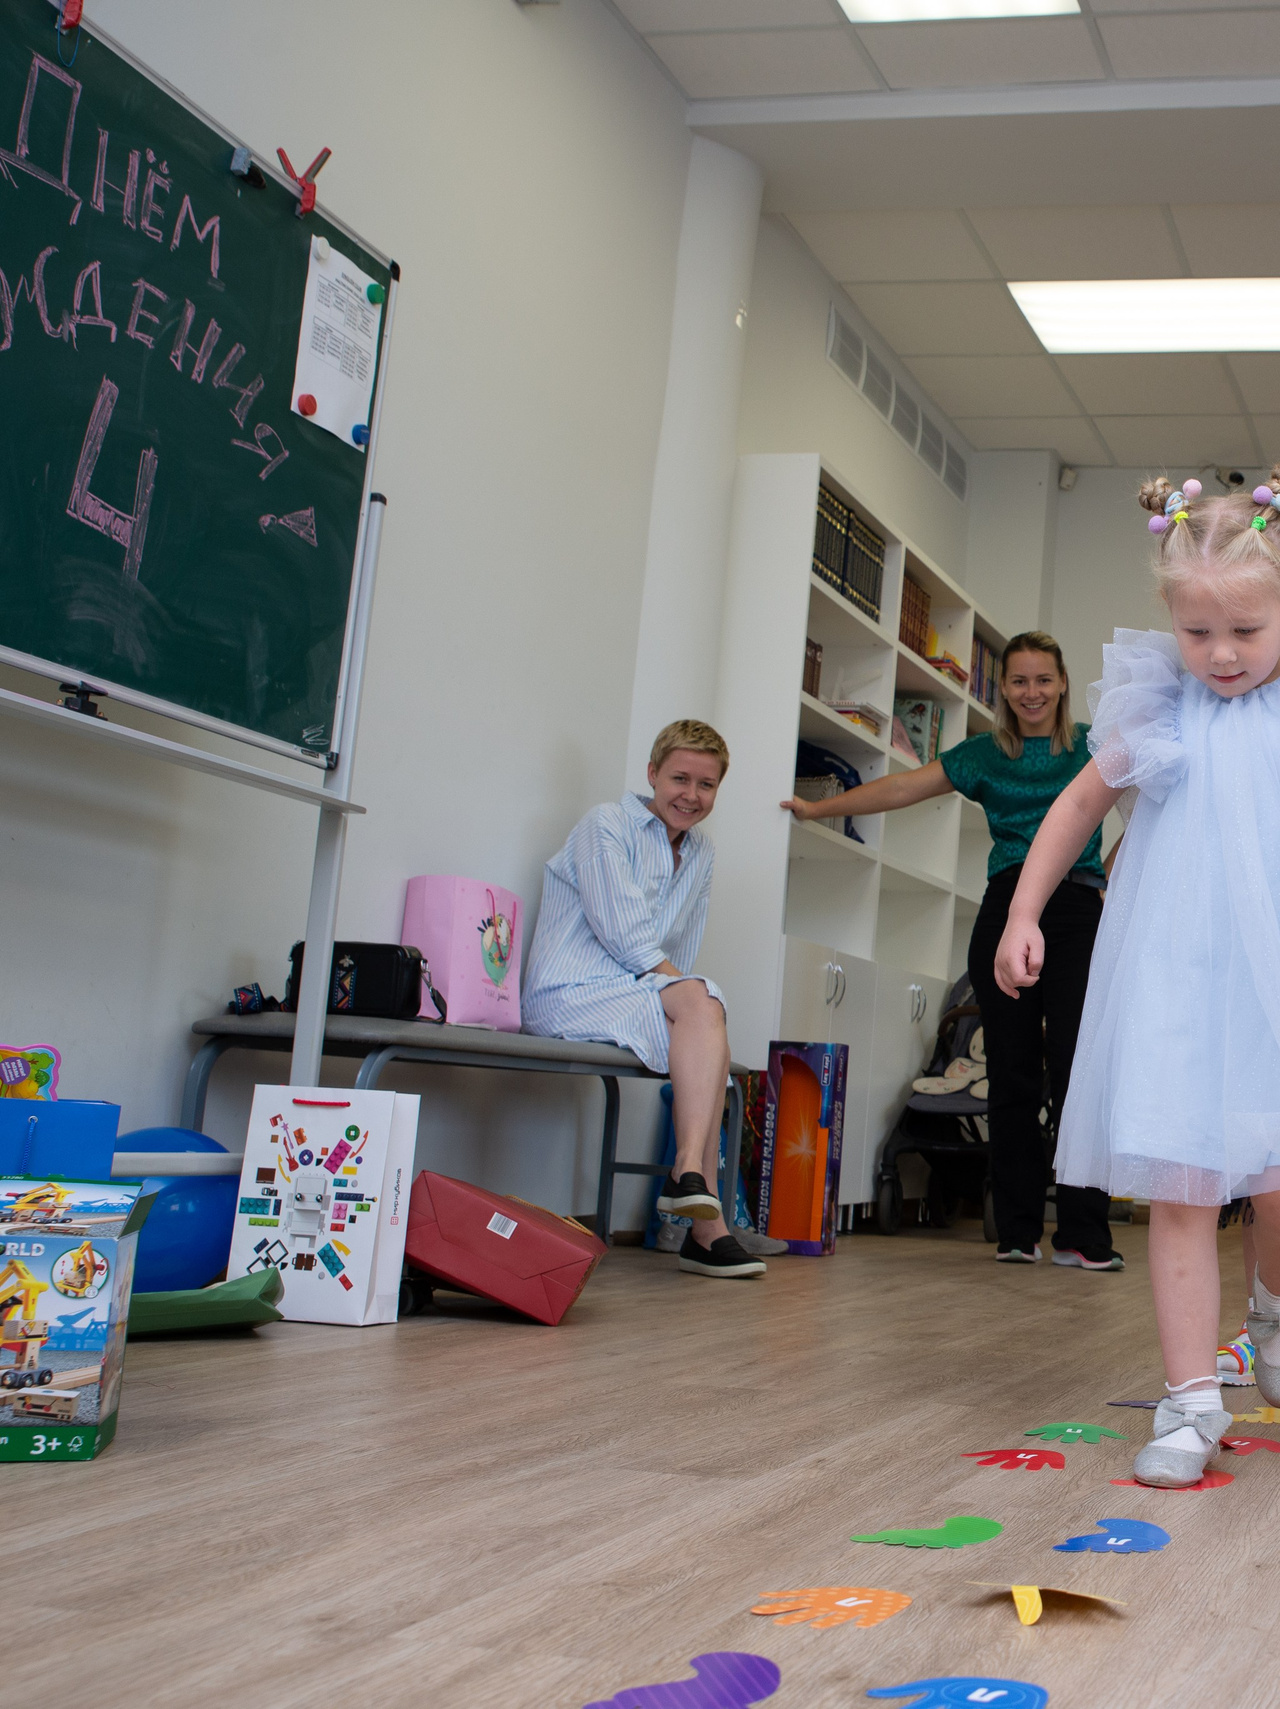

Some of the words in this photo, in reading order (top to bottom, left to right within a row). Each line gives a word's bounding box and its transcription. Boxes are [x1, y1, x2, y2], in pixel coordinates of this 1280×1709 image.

[66, 373, 158, 580] 4
[763, 1103, 775, 1158] РОБОТЫ
[762, 1160, 771, 1177] НА
[30, 1434, 62, 1455] 3+
